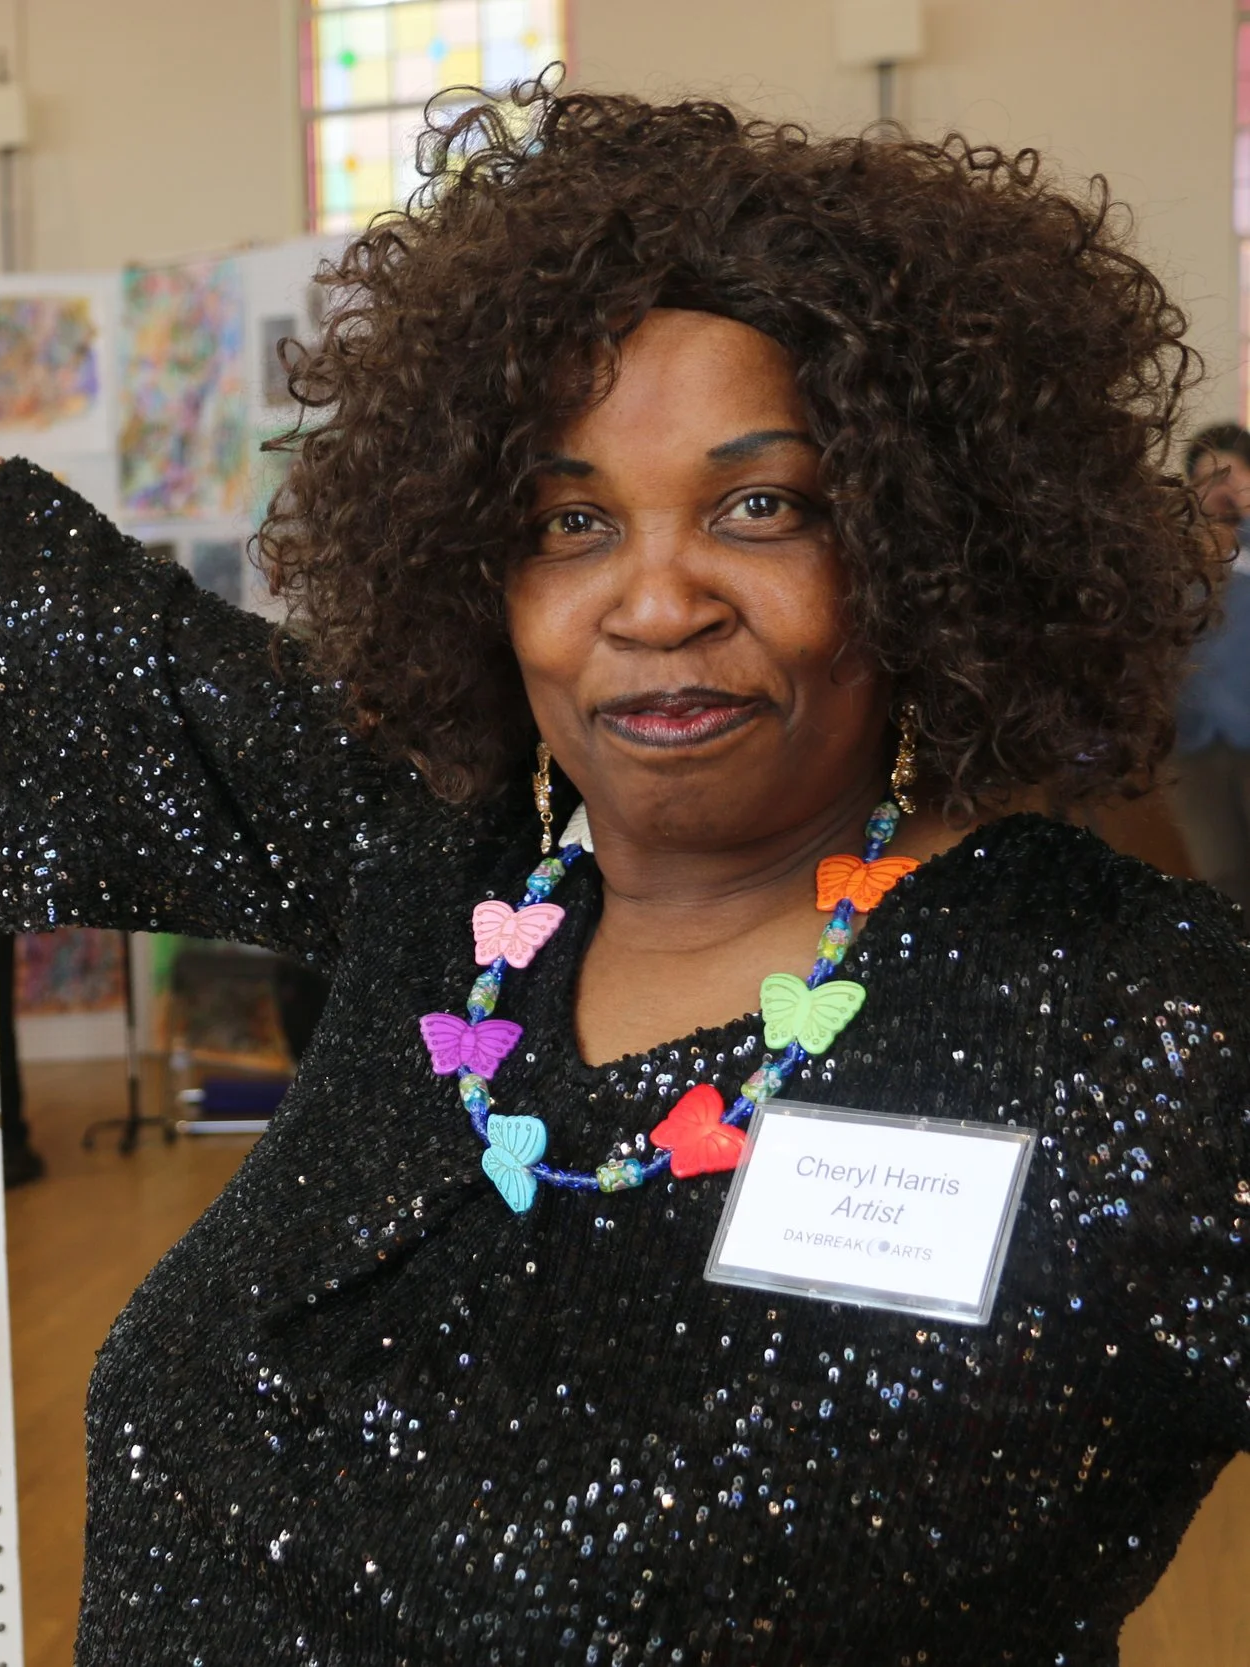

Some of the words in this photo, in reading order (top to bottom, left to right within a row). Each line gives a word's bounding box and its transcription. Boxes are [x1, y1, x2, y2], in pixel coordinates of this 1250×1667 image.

[796, 1156, 876, 1188] Cheryl
[884, 1167, 960, 1196] Harris
[830, 1195, 905, 1225] Artist
[783, 1229, 865, 1252] DAYBREAK
[890, 1244, 933, 1261] ARTS
